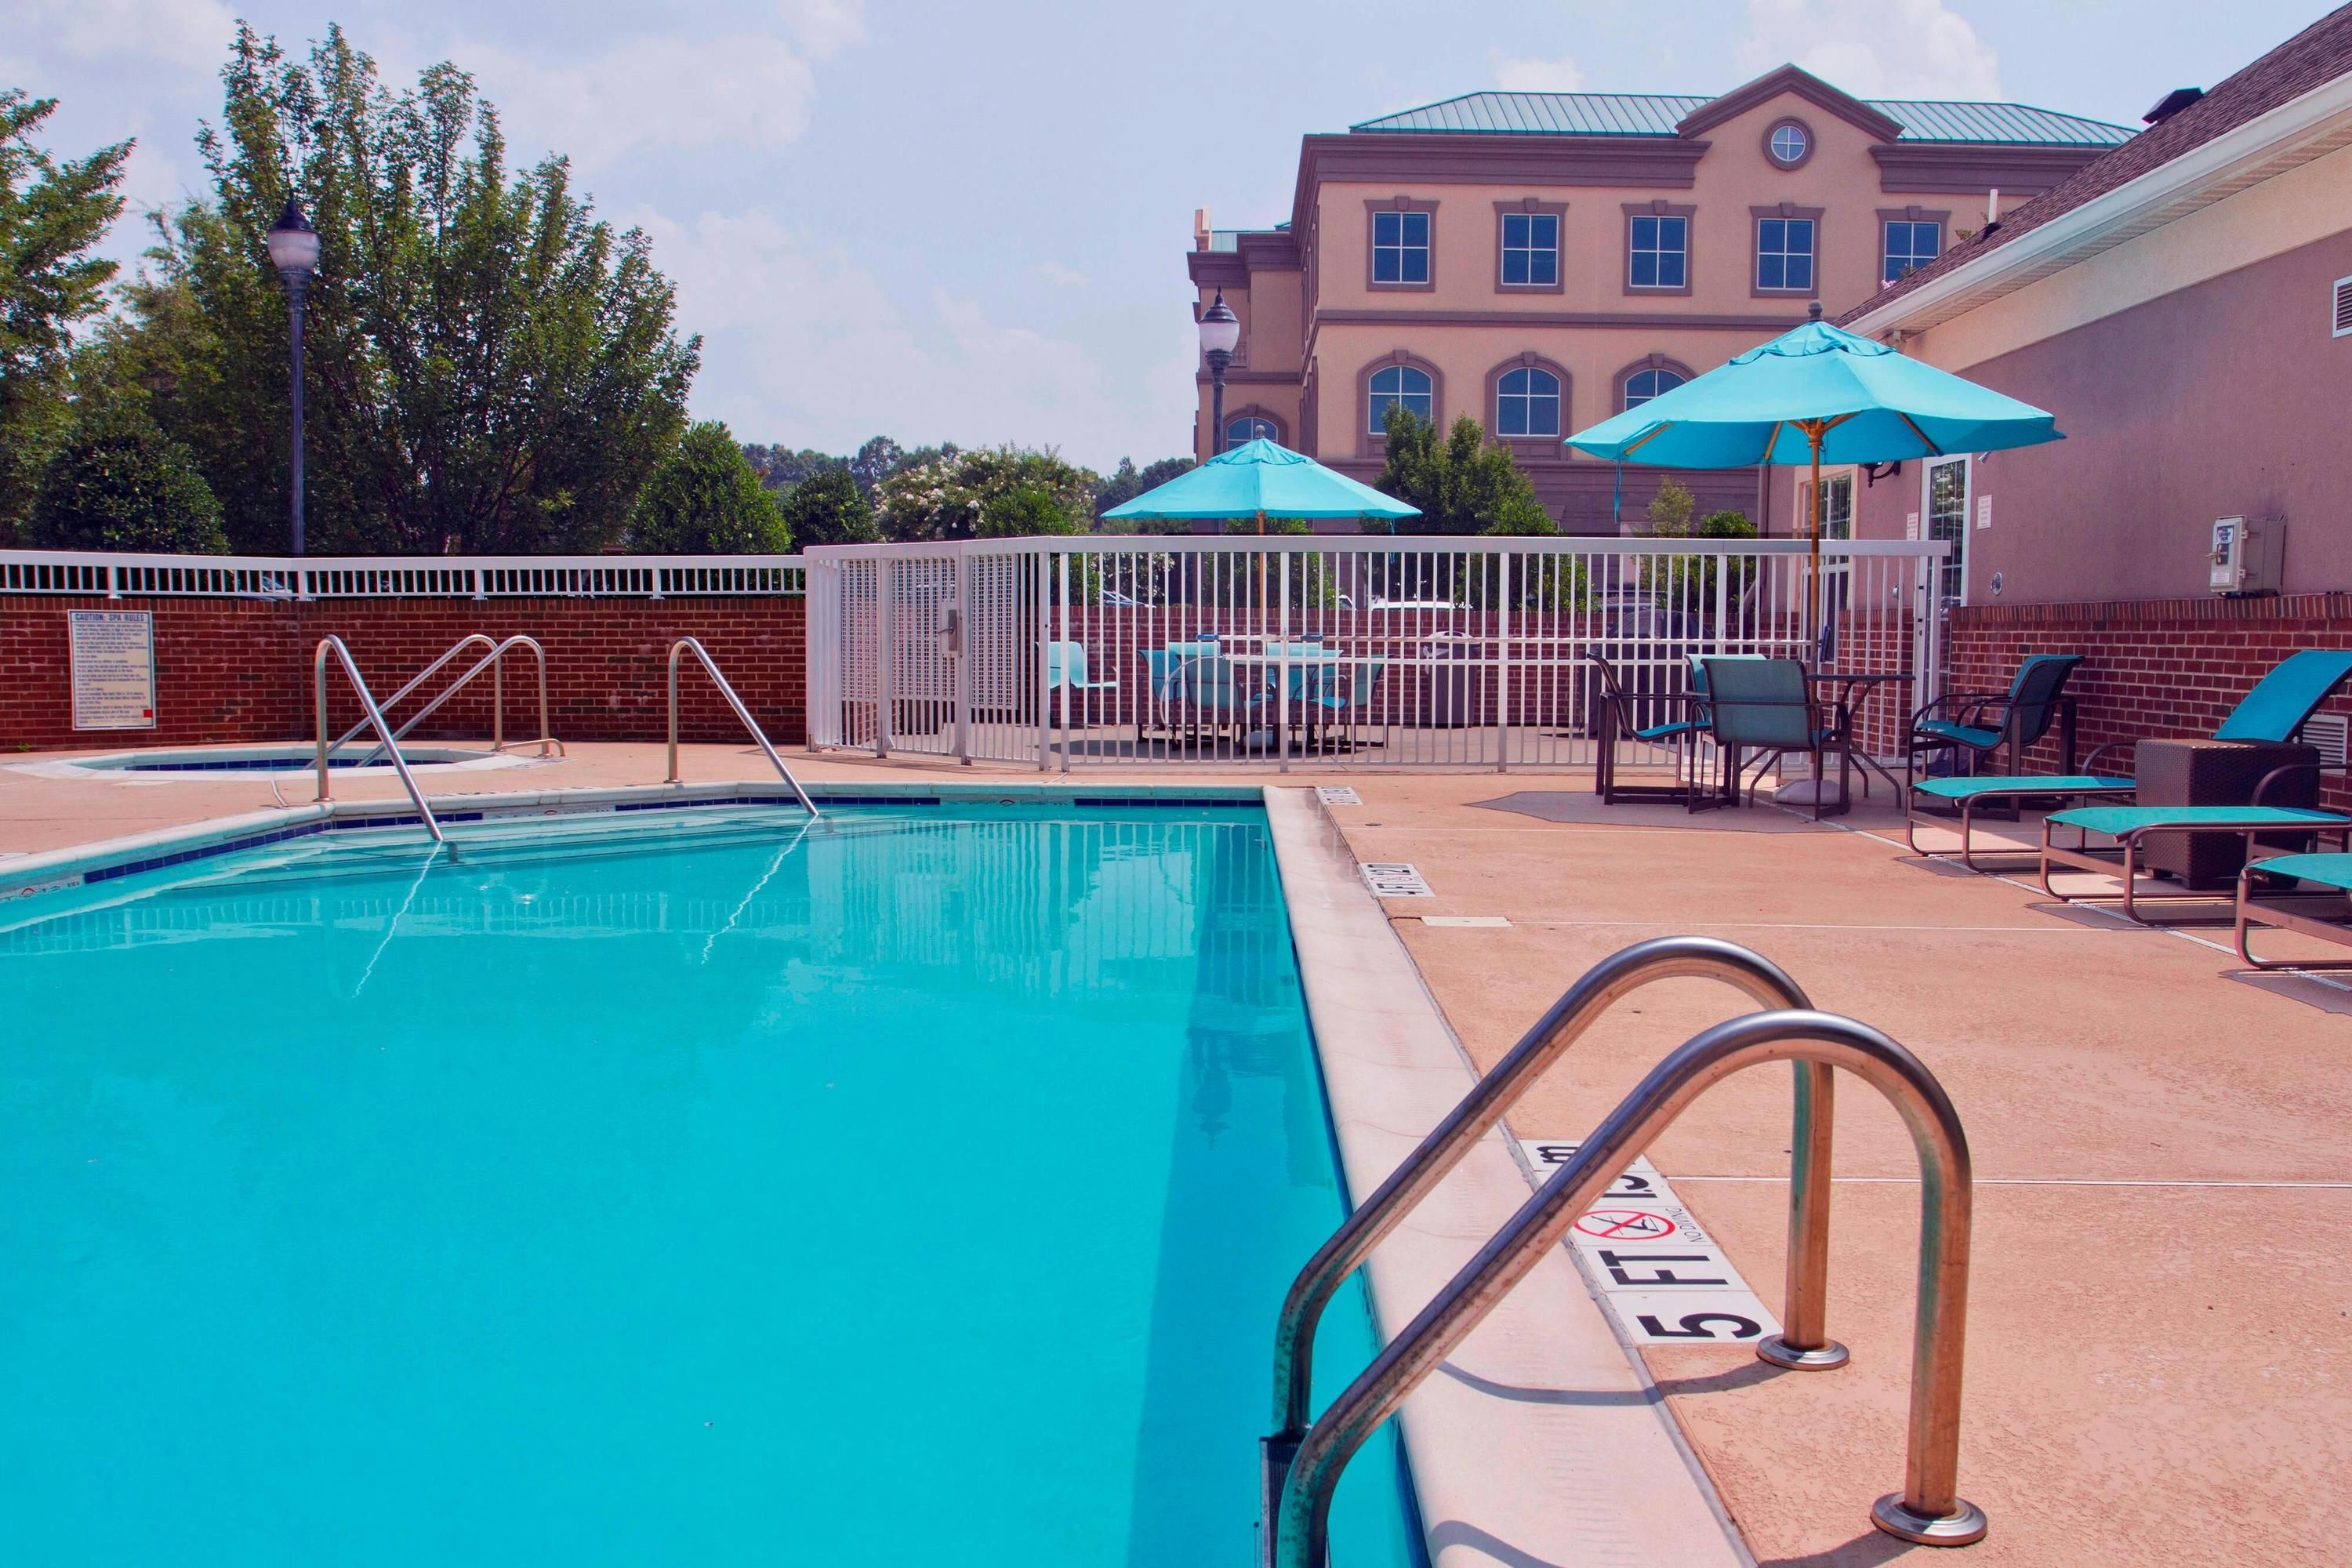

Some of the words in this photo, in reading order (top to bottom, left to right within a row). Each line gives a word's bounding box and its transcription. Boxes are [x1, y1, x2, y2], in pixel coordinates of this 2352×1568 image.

[1665, 1207, 1697, 1230] DIVING
[1684, 1231, 1707, 1243] NO
[1597, 1250, 1730, 1285] FT
[1635, 1312, 1762, 1338] 5
